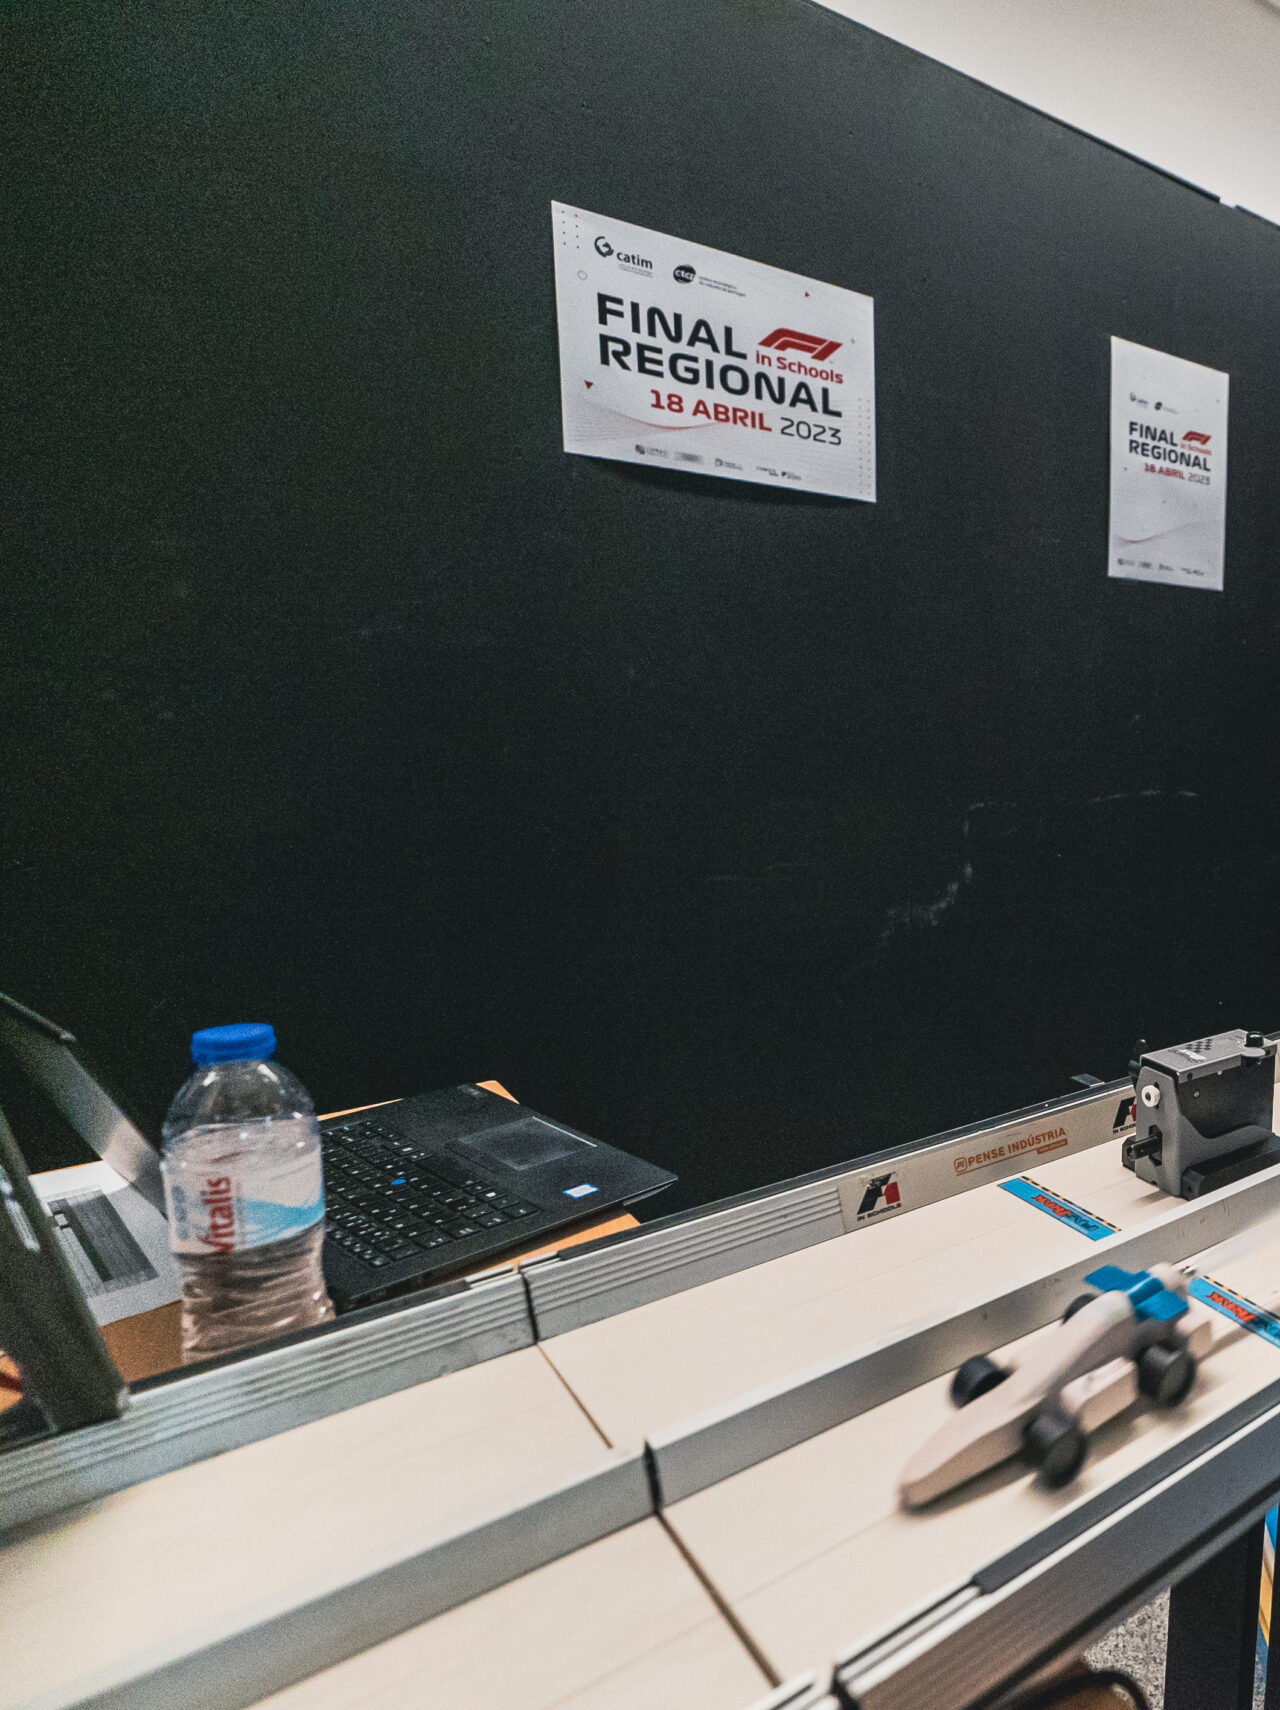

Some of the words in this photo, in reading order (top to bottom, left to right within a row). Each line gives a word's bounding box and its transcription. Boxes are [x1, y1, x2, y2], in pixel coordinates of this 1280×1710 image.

[616, 251, 653, 269] catim
[597, 292, 747, 360] FINAL
[599, 333, 843, 418] REGIONAL
[756, 350, 772, 367] in
[777, 356, 843, 385] Schools
[650, 389, 684, 414] 18
[692, 399, 773, 432] ABRIL
[780, 416, 842, 446] 2023
[1129, 420, 1178, 447] FINAL
[1129, 439, 1211, 472] REGIONAL
[968, 1146, 1006, 1166] PENSE
[1008, 1127, 1066, 1153] INDÚSTRIA
